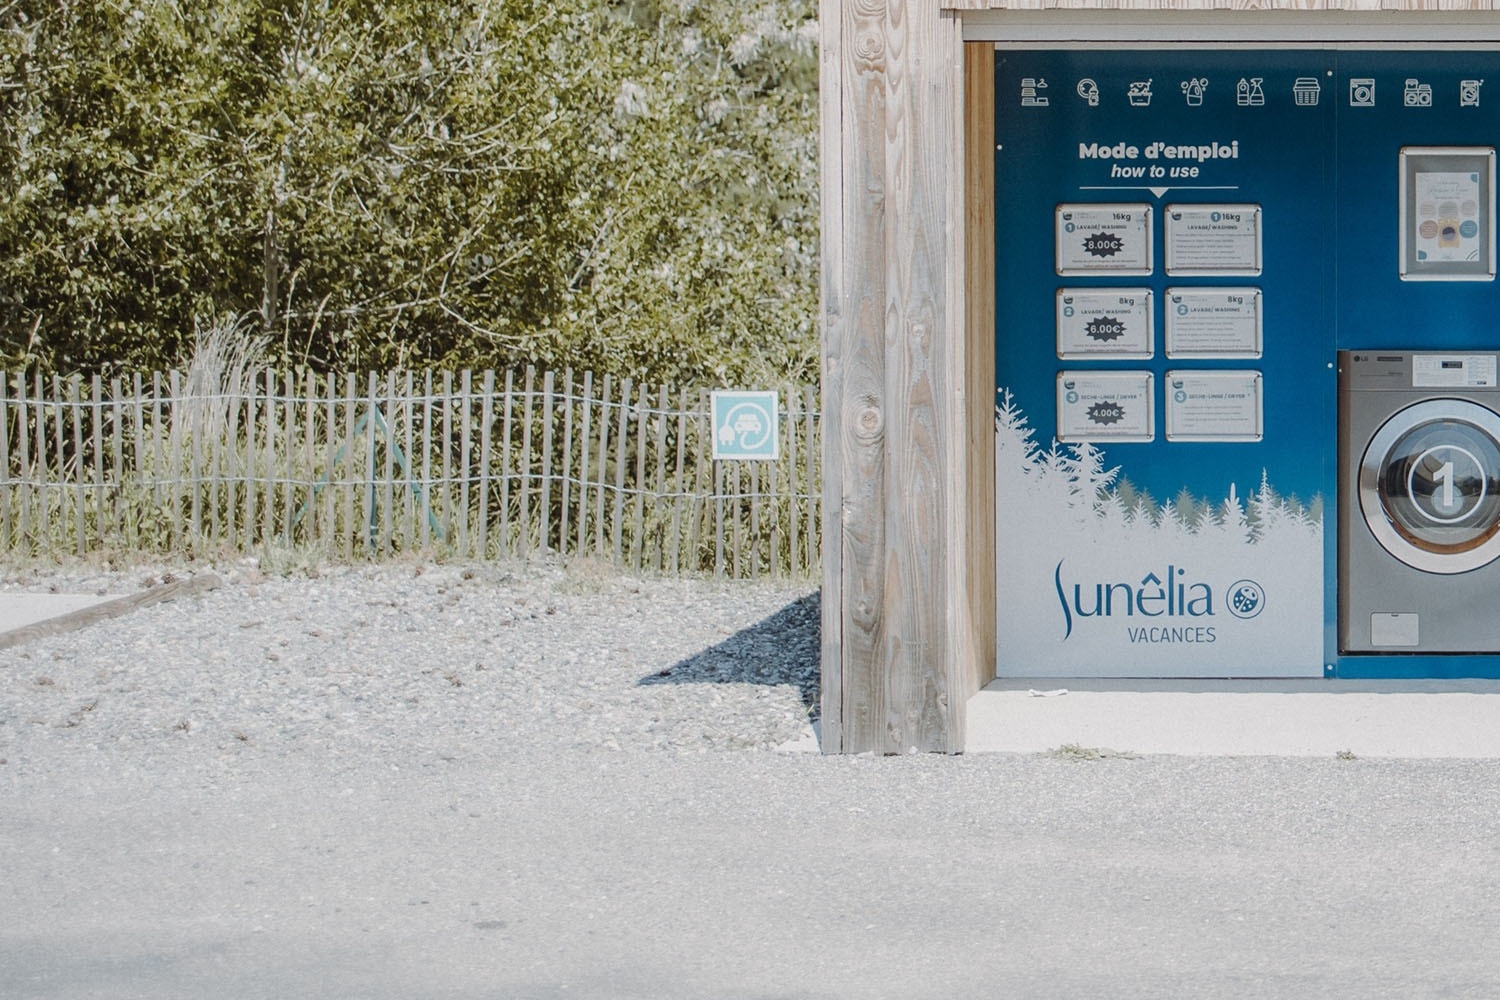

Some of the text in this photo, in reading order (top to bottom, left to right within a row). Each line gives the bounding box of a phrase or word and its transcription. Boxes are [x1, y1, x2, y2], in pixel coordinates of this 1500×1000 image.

[1079, 142, 1139, 159] Mode
[1111, 163, 1200, 178] how to use
[1088, 240, 1119, 249] 8.00€
[1090, 325, 1120, 333] 6.00€
[1093, 409, 1120, 417] 4.00€
[1432, 461, 1454, 507] 1
[1054, 558, 1216, 641] Sunêlia
[1128, 626, 1216, 643] VACANCES
